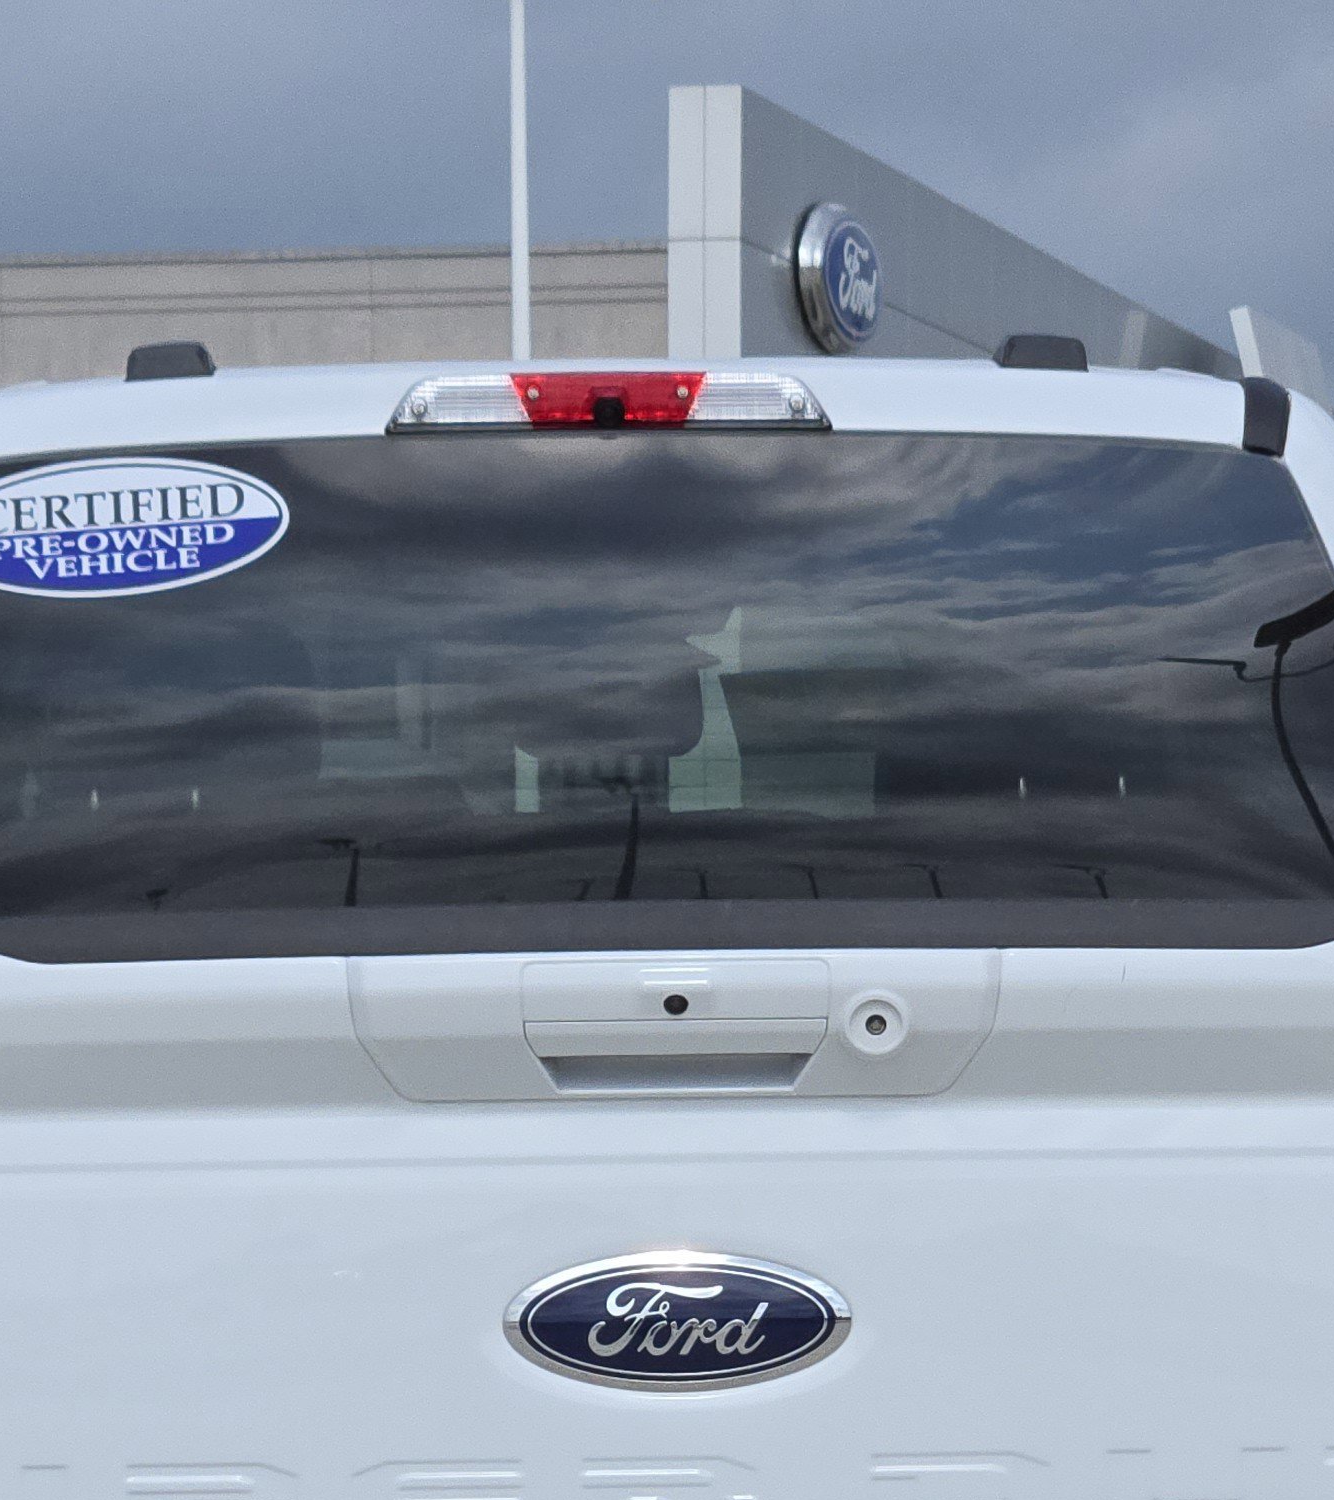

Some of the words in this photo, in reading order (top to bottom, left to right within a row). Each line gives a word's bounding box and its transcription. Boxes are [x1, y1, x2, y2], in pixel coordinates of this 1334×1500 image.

[839, 236, 879, 321] Ford
[25, 547, 201, 580] VEHICLE
[588, 1282, 769, 1357] Ford
